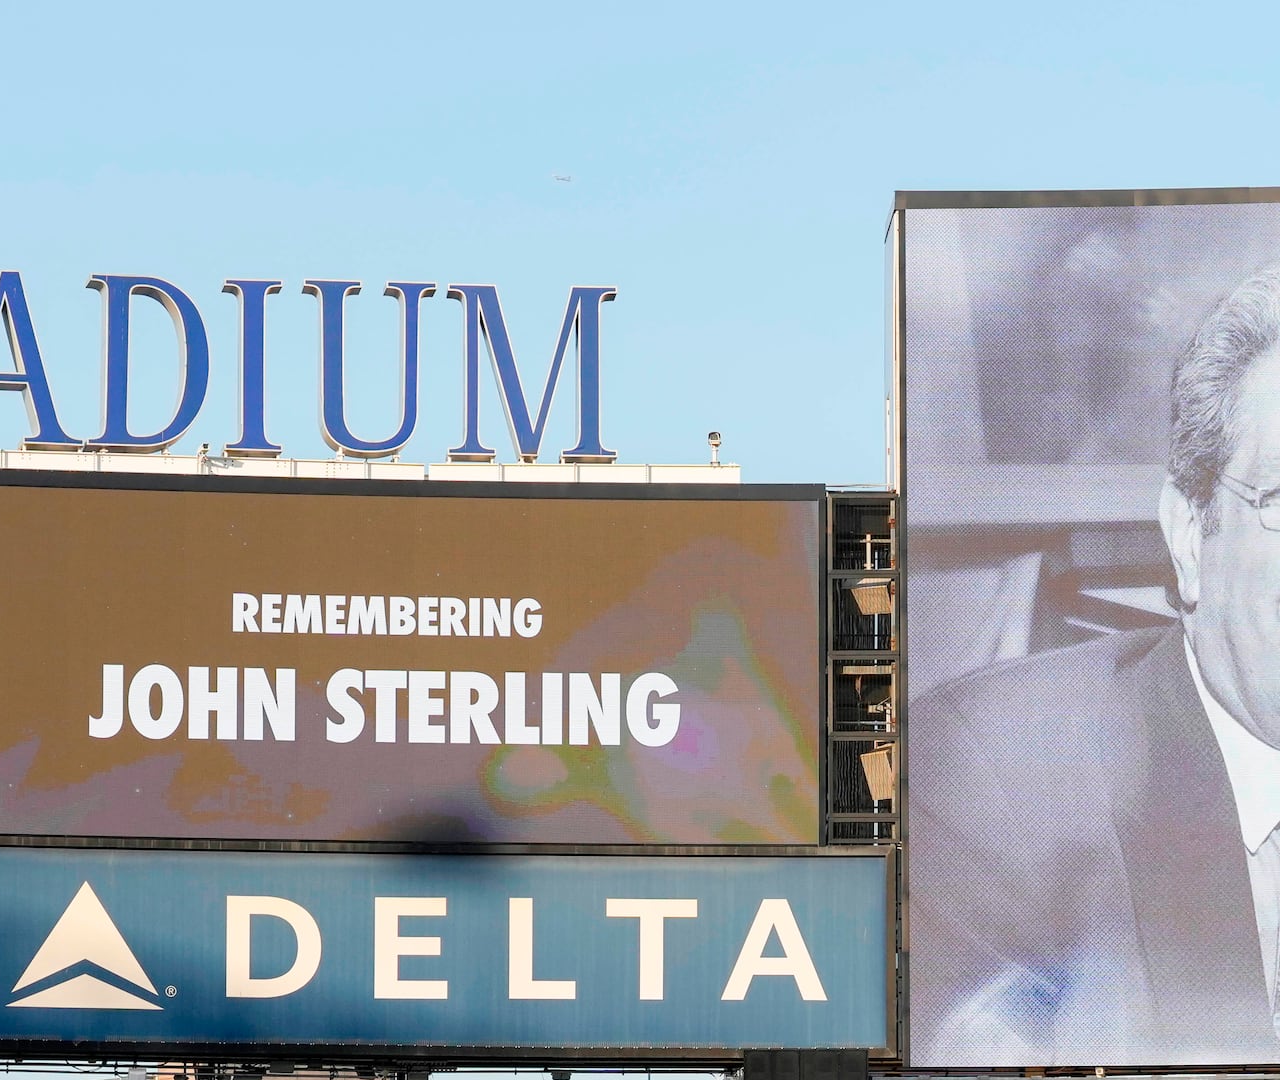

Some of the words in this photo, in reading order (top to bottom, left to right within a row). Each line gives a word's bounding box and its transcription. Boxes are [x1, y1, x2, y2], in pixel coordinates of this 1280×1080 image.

[232, 592, 543, 638] REMEMBERING
[88, 664, 296, 741] JOHN
[324, 668, 681, 748] STERLING
[225, 895, 828, 1002] DELTA
